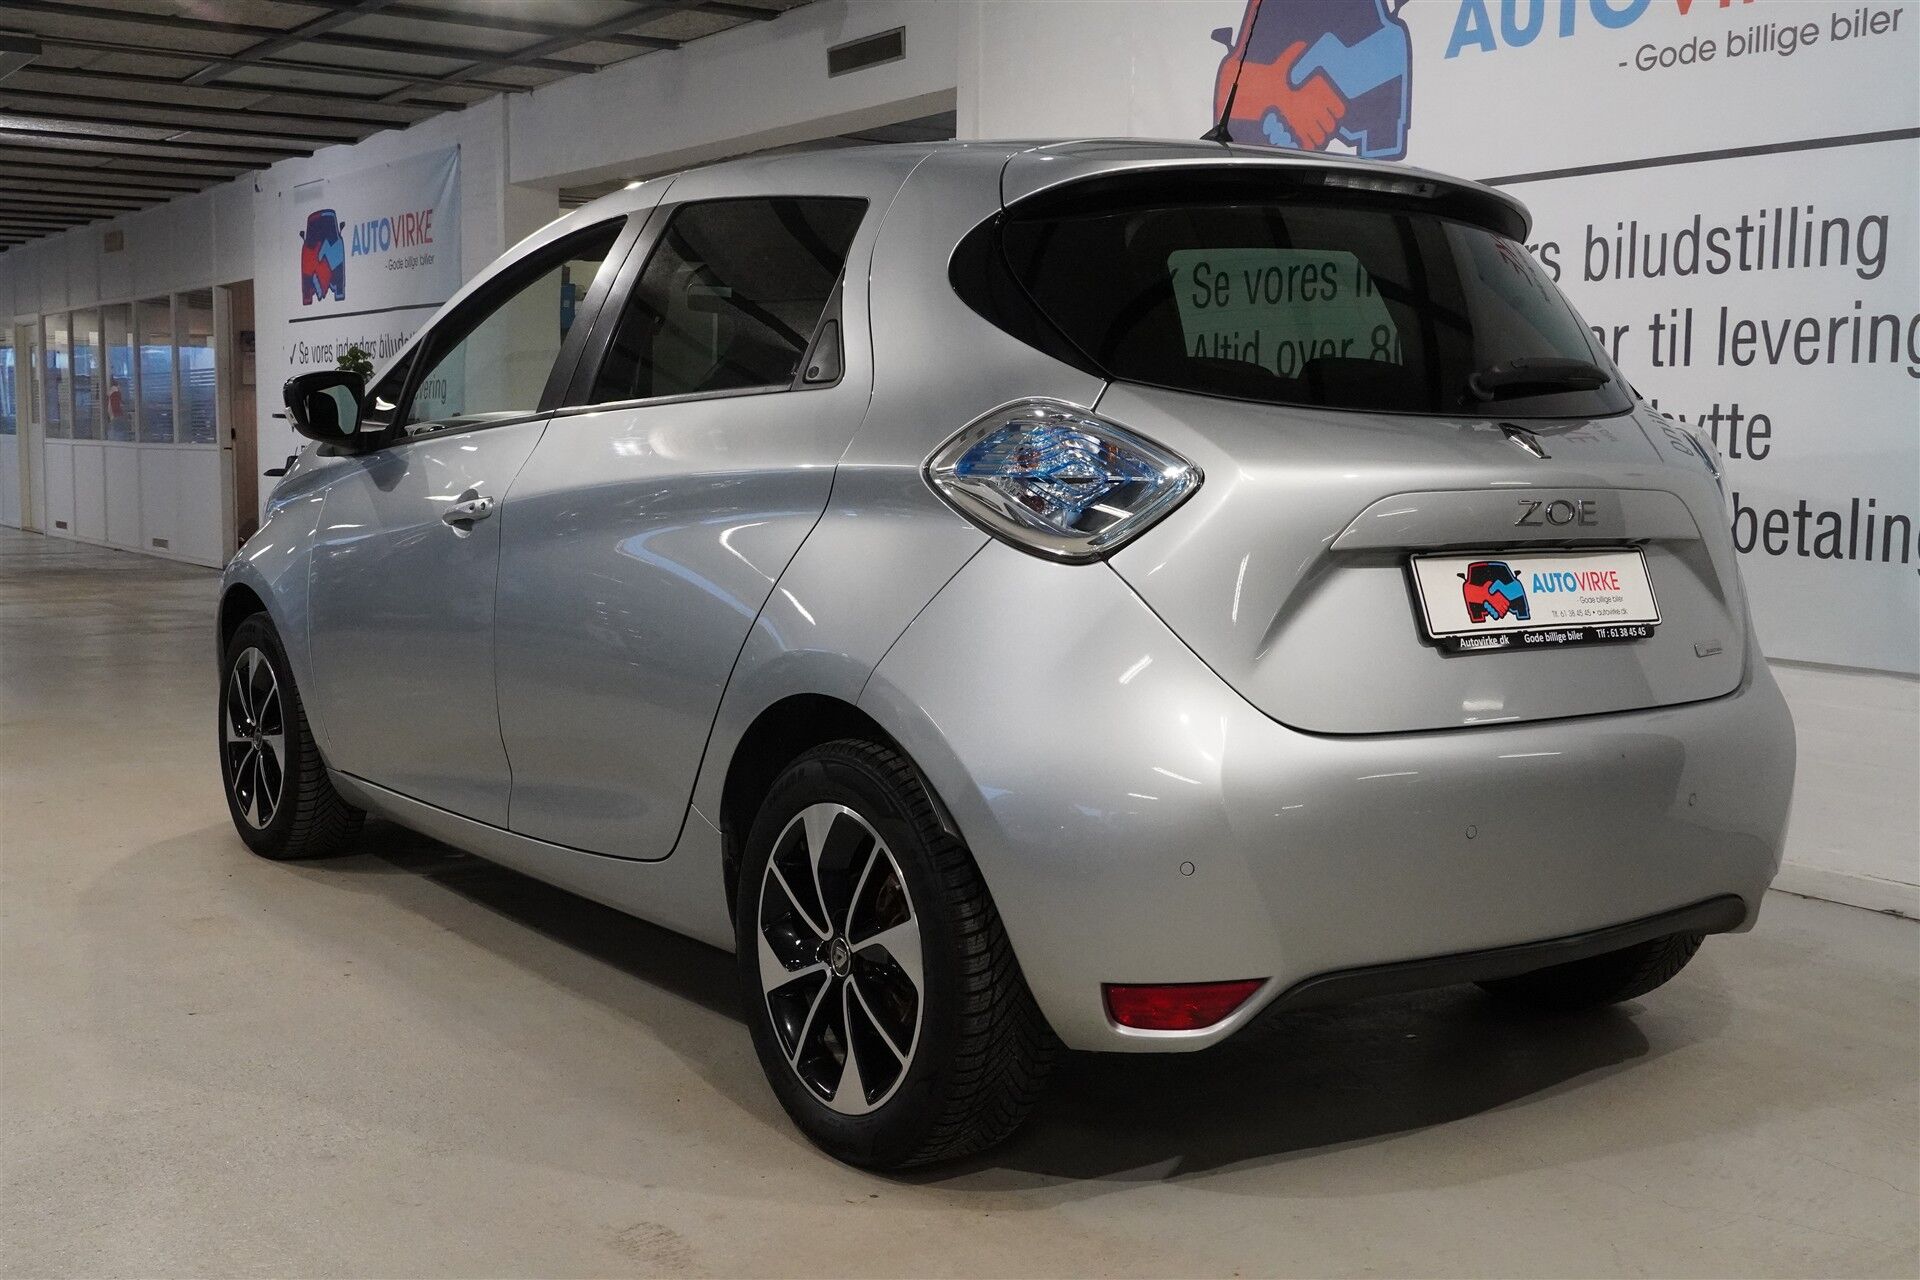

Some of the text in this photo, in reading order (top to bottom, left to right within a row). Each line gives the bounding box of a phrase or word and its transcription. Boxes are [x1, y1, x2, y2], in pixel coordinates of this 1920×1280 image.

[1635, 36, 1717, 71] Gode
[1726, 23, 1820, 56] billige
[1830, 8, 1904, 41] biler
[351, 208, 434, 257] AUTOVIRKE
[1584, 205, 1890, 281] biludstilling
[1192, 261, 1230, 309] Se
[1244, 260, 1338, 305] vores
[299, 341, 309, 364] Se
[311, 343, 333, 364] vores
[1648, 307, 1693, 367] til
[1512, 499, 1599, 527] ZOE
[1731, 492, 1920, 576] betalin
[1532, 570, 1621, 594] AUTOVIRKE
[1524, 632, 1545, 643] Gode
[1566, 630, 1584, 641] biler
[1610, 628, 1619, 638] 61
[1619, 627, 1629, 637] 38
[1628, 626, 1638, 637] 45
[1638, 626, 1647, 637] 45
